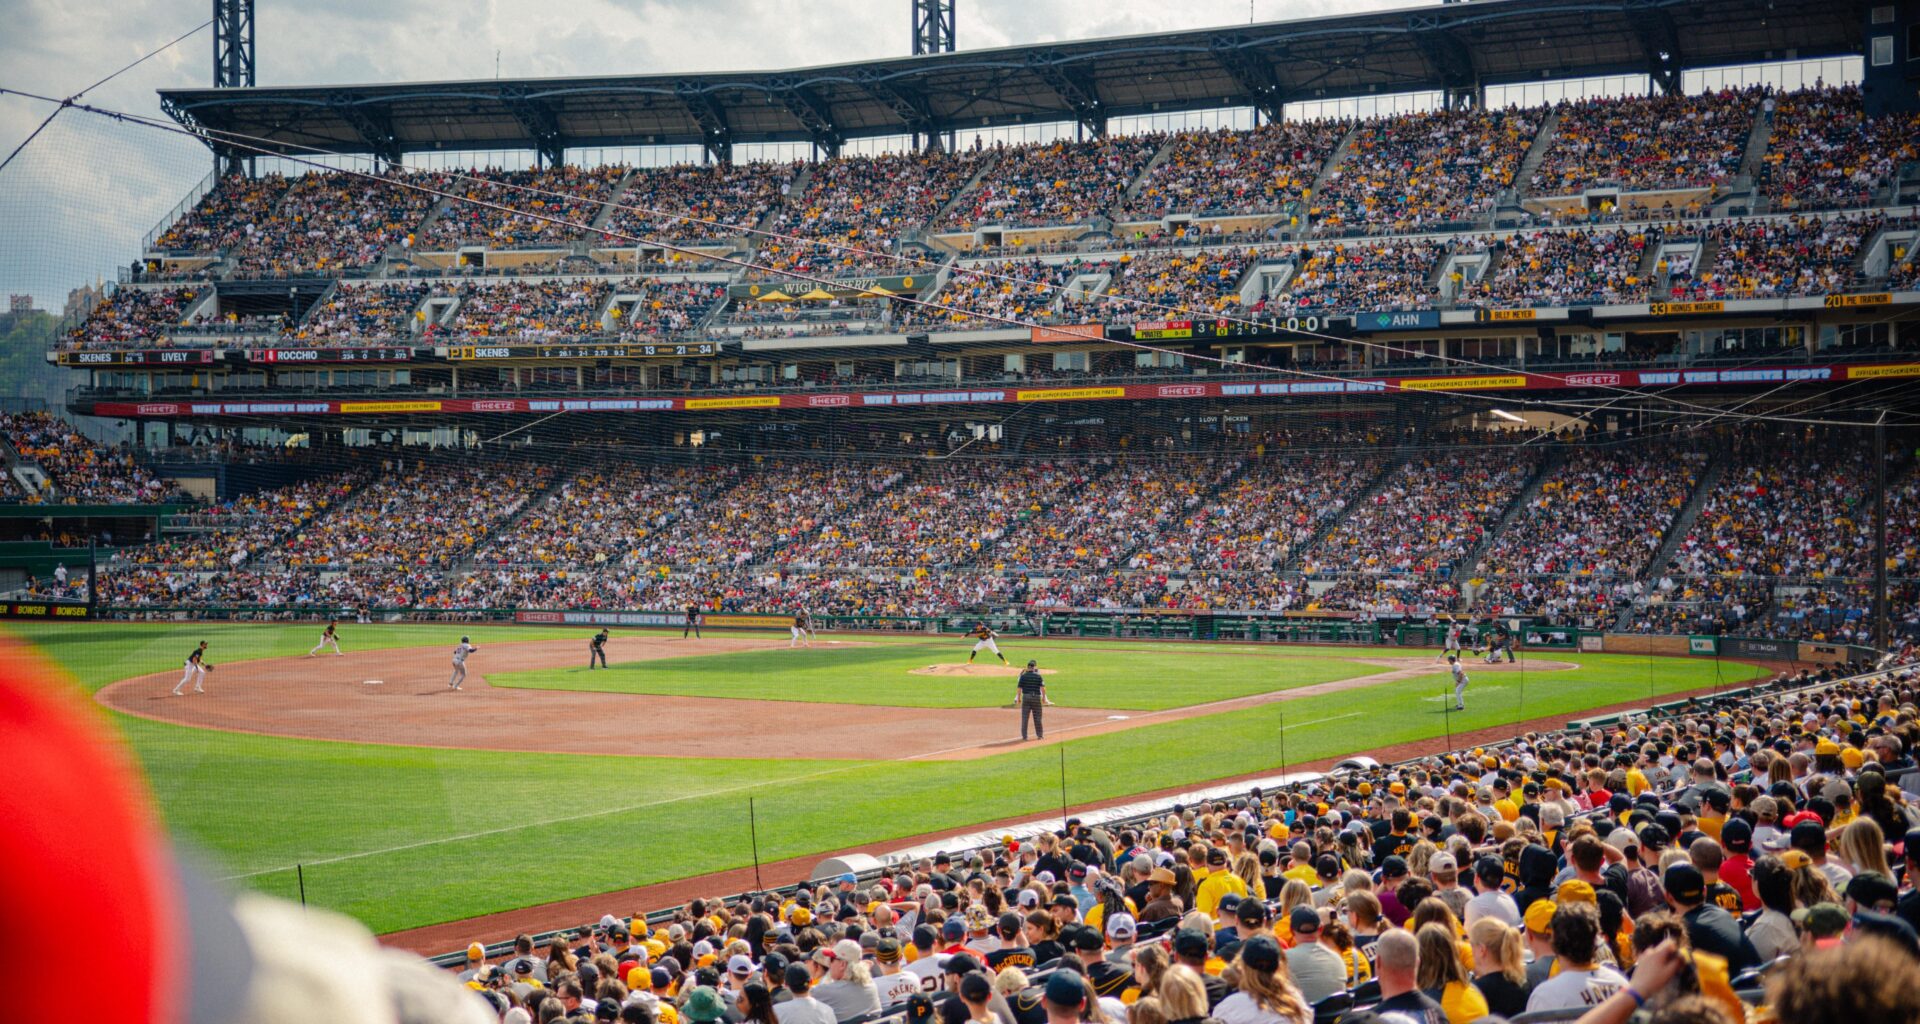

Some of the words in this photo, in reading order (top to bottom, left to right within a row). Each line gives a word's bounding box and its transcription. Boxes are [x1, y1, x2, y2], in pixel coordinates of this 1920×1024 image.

[1826, 295, 1841, 308] 20
[1847, 296, 1856, 304] PIE
[1860, 294, 1888, 303] TRAYNOR
[1650, 302, 1666, 315] 33
[1670, 303, 1692, 312] HONUS
[1694, 302, 1720, 311] WAGNER
[1479, 309, 1485, 321] 1
[1494, 311, 1510, 319] BILLY
[1512, 310, 1532, 319] MEYER
[1219, 319, 1225, 327] 0
[1270, 318, 1277, 333] 1
[1287, 317, 1299, 332] 0
[1306, 316, 1319, 332] 0
[1392, 314, 1420, 327] AHN
[1198, 323, 1205, 333] 3
[1219, 328, 1225, 336] 0
[1237, 327, 1243, 335] 2
[1251, 327, 1258, 335] 0
[1141, 330, 1163, 338] PIRATES
[475, 348, 510, 358] SKENES
[645, 346, 655, 355] 13
[676, 345, 686, 355] 21
[700, 345, 712, 354] 34
[79, 352, 112, 363] SKENES
[161, 352, 188, 362] LIVELY
[277, 350, 318, 361] ROCCHIO
[1569, 376, 1617, 385] SHEETZ
[1638, 373, 1680, 384] WHY
[1683, 371, 1718, 383] THE
[1161, 387, 1203, 395] SHEETZ
[140, 405, 175, 413] SHEETZ
[17, 605, 47, 615] BOWSER
[56, 606, 88, 616] BOWSER
[524, 613, 559, 622] SHEETZ
[564, 613, 591, 624] WHY
[594, 613, 617, 624] THE
[619, 613, 666, 624] SHEETZ
[920, 973, 945, 993] 21
[917, 1005, 925, 1017] P
